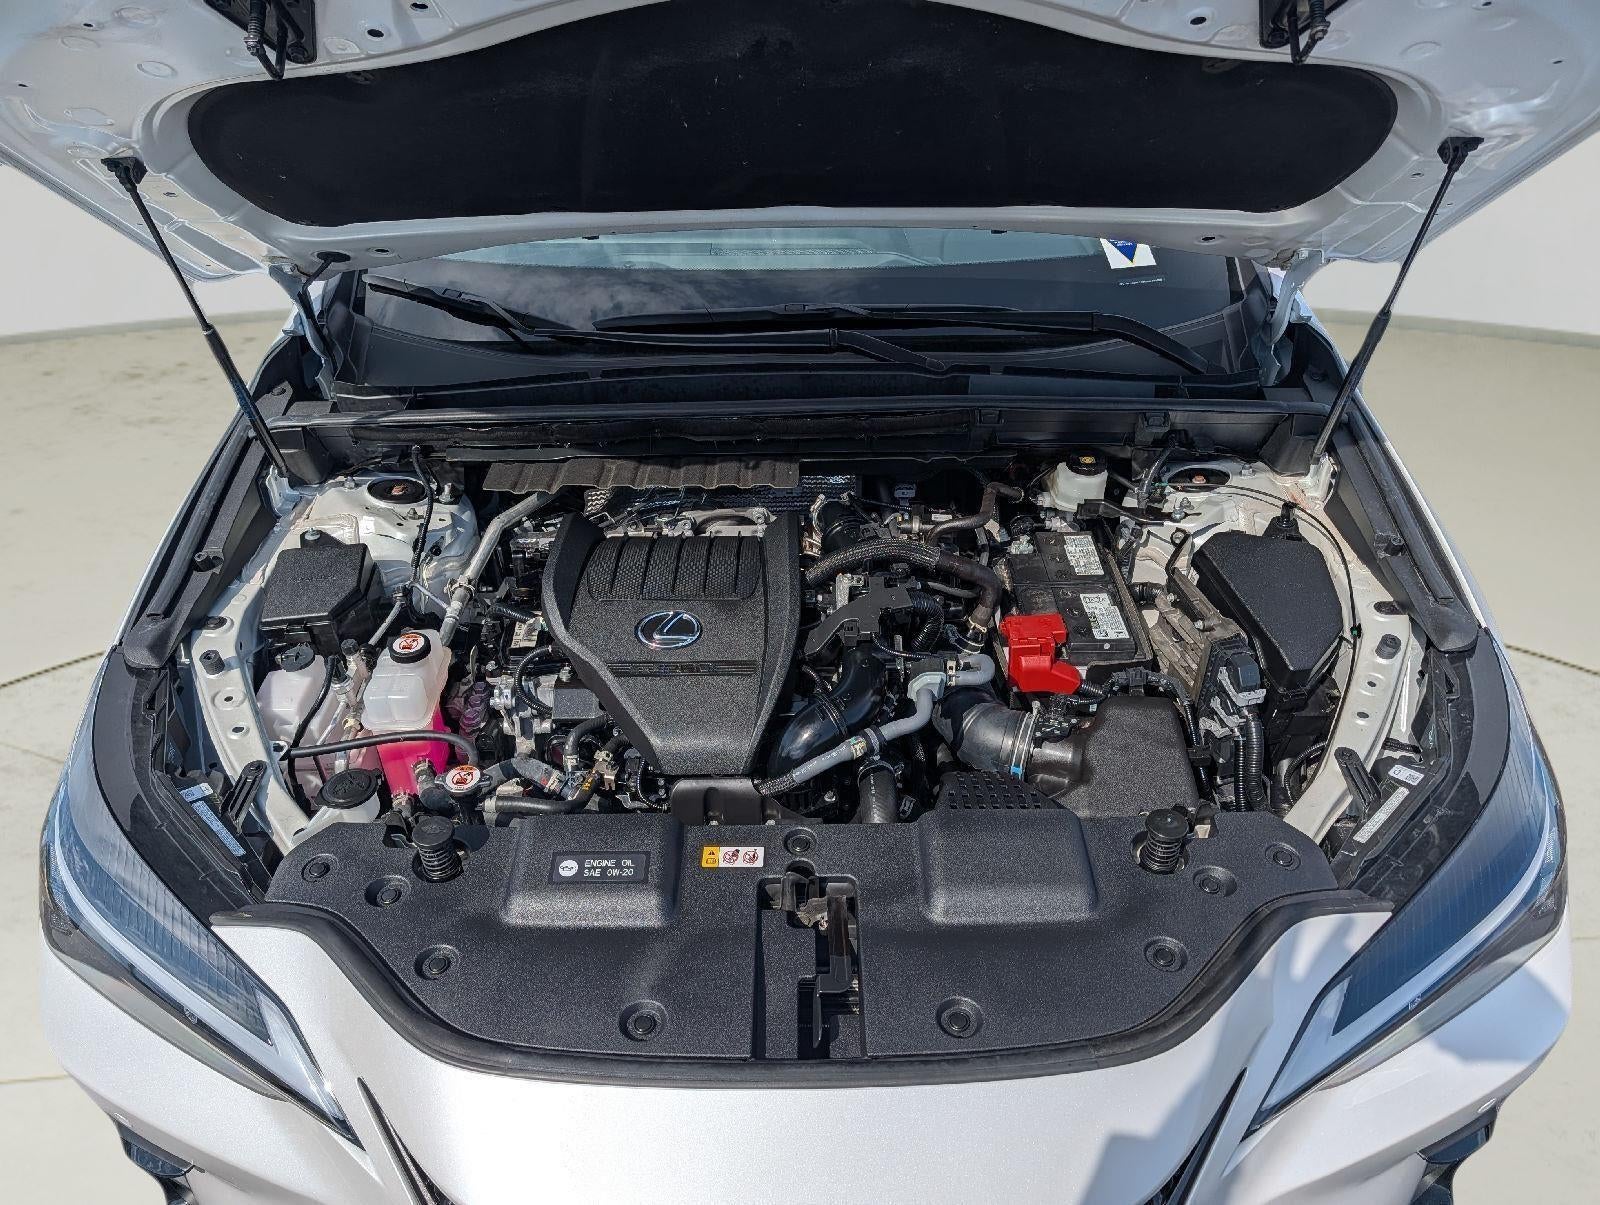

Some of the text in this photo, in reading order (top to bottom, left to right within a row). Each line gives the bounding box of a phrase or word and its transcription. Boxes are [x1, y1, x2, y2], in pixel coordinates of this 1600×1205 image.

[584, 859, 635, 868] ENGINE OIL
[583, 868, 634, 877] SAE 0W-20
